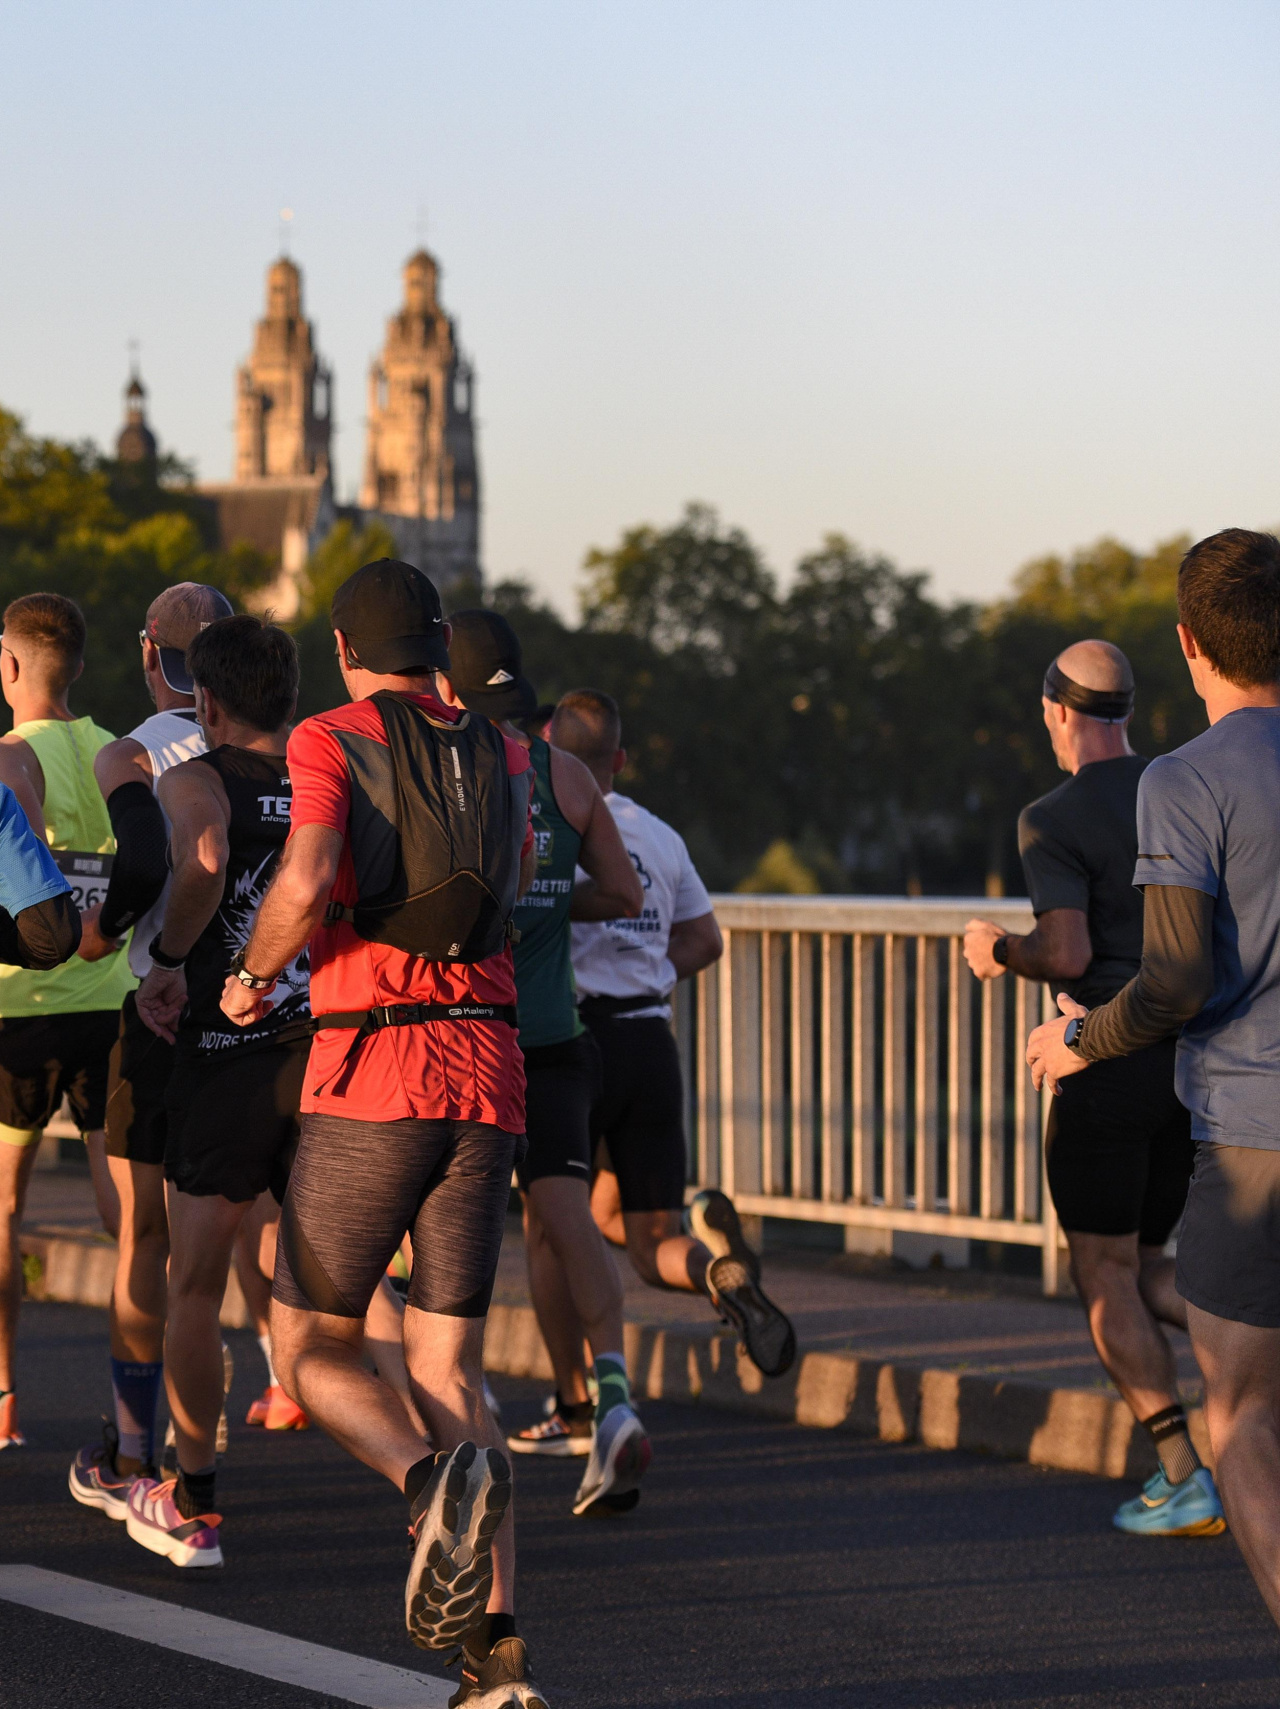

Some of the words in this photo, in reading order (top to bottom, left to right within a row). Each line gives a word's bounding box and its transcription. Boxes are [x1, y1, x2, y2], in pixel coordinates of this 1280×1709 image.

[456, 782, 466, 811] EVADICT
[72, 886, 109, 911] 26
[463, 1007, 495, 1017] Kalenji
[198, 1031, 240, 1050] NOTRE
